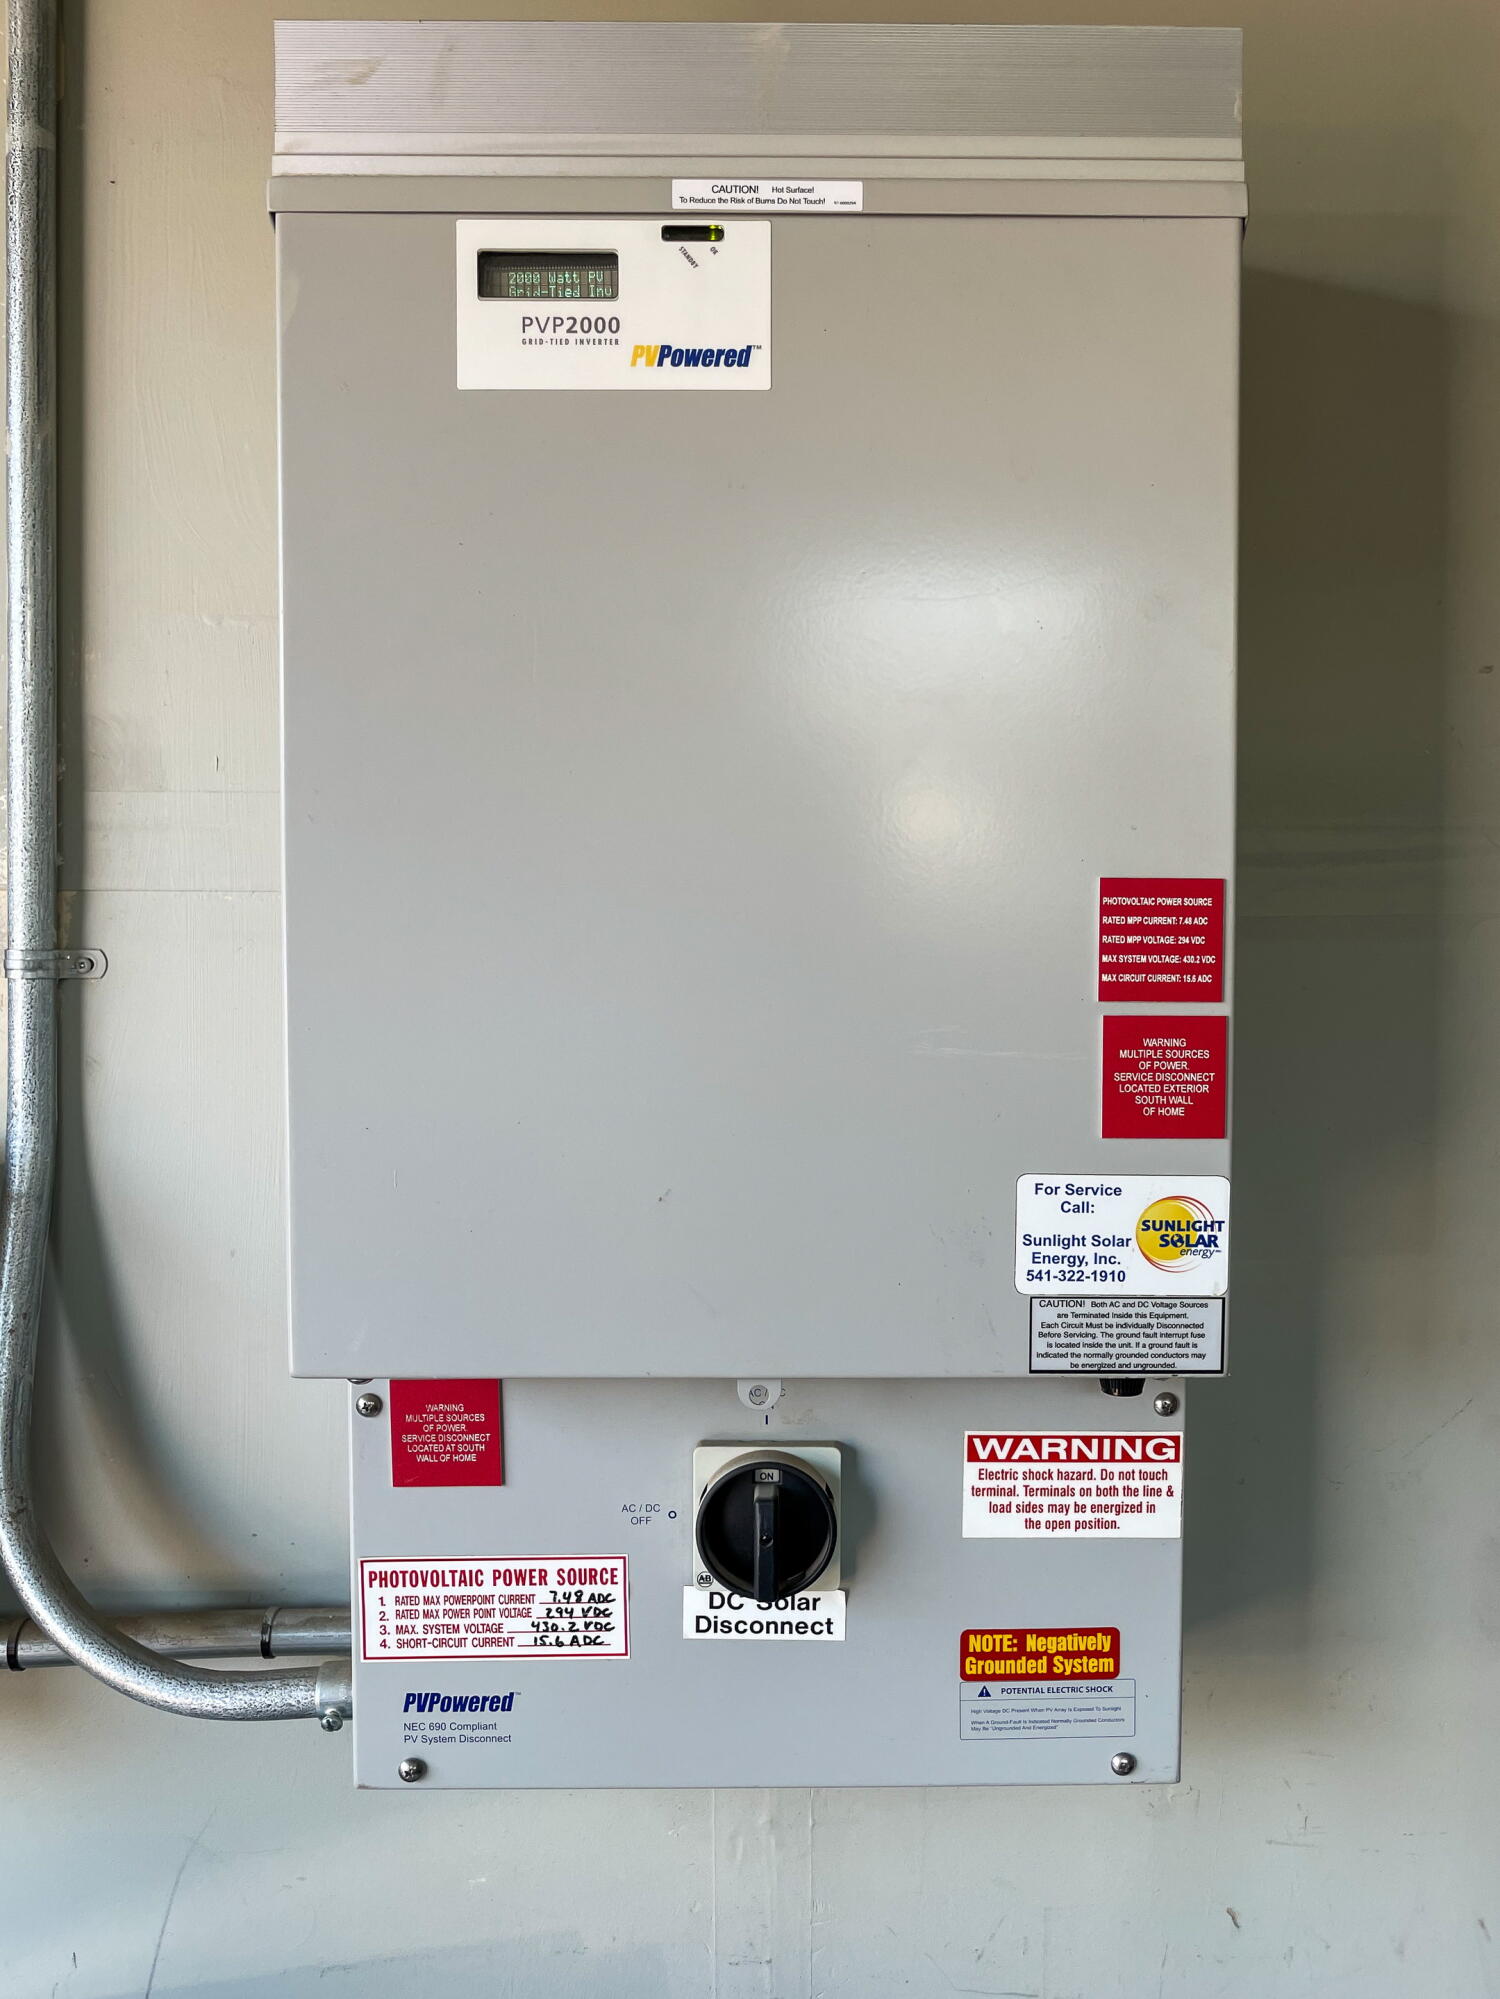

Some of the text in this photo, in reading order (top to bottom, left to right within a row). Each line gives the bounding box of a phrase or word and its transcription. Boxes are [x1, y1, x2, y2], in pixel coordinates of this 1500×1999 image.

[712, 185, 758, 194] CAUTION!
[710, 246, 718, 255] OK
[679, 246, 699, 269] STANDBY
[508, 271, 603, 284] 2000 Watt PV
[522, 316, 620, 334] PVP2000
[1102, 897, 1212, 906] PHOTOVOLTAIC POWER SOURCE
[1102, 916, 1125, 924] RATED
[1127, 916, 1142, 924] MPP
[1193, 917, 1208, 925] ADC
[1102, 936, 1205, 944] RATED MPP VOLTAGE: 294 VDC
[1102, 954, 1116, 962] MAX
[1118, 955, 1146, 963] SYSTEM
[1148, 955, 1181, 963] VOLTAGE:
[1183, 955, 1200, 963] 430.2
[1143, 1038, 1186, 1047] WARNING
[1120, 1050, 1209, 1058] MULTIPLE SOURCES
[1139, 1061, 1189, 1070] OF POWER.
[1114, 1072, 1215, 1081] SERVICE DISCONNECT
[1120, 1084, 1209, 1093] LOCATED EXTERIOR
[1135, 1096, 1193, 1104] SOUTH WALL
[1143, 1107, 1184, 1116] OF HOME
[1035, 1183, 1122, 1196] For Service
[1061, 1201, 1094, 1213] Call:
[1141, 1220, 1225, 1232] SUNLIGHT
[1023, 1234, 1132, 1250] Sunlight Solar
[1159, 1234, 1219, 1247] SOLAR
[1032, 1252, 1120, 1267] Energy, Inc.
[1026, 1270, 1125, 1282] 541-322-1910
[1039, 1300, 1085, 1308] CAUTION!
[426, 1404, 464, 1412] WARNING
[406, 1414, 484, 1422] MULTIPLE SOURCES
[972, 1438, 1176, 1460] WARNING
[760, 1472, 773, 1480] ON
[978, 1468, 1168, 1480] Electric shock hazard. Do not touch
[972, 1485, 1174, 1497] terminal. Terminals on both the line &
[622, 1504, 636, 1512] AC
[646, 1504, 660, 1512] DC
[989, 1501, 1155, 1516] load sides may be energized in
[631, 1516, 651, 1525] OFF
[1025, 1518, 1120, 1532] the open position.
[368, 1568, 618, 1588] PHOTOVOLTAIC POWER SOURCE
[395, 1596, 420, 1606] RATED
[423, 1596, 440, 1605] MAX
[444, 1594, 495, 1606] POWERPOINT
[498, 1594, 536, 1605] CURRENT
[549, 1590, 616, 1604] 7.48 ADC
[709, 1592, 744, 1610] DC
[379, 1608, 532, 1621] 2. RATED MAX POWER POINT VOLTAGE
[546, 1606, 613, 1619] 294 VDC
[380, 1623, 504, 1635] 3. MAX. SYSTEM VOLTAGE
[531, 1621, 616, 1632] 430.2 VDC
[696, 1616, 833, 1635] Disconnect
[380, 1637, 515, 1649] 4. SHORT-CIRCUIT CURRENT
[570, 1635, 604, 1647] ADC
[969, 1633, 1111, 1653] NOTE: Negatively
[966, 1655, 1114, 1675] Grounded System
[403, 1722, 497, 1732] NEC 690 Compliant
[404, 1734, 511, 1745] PV System Disconnect
